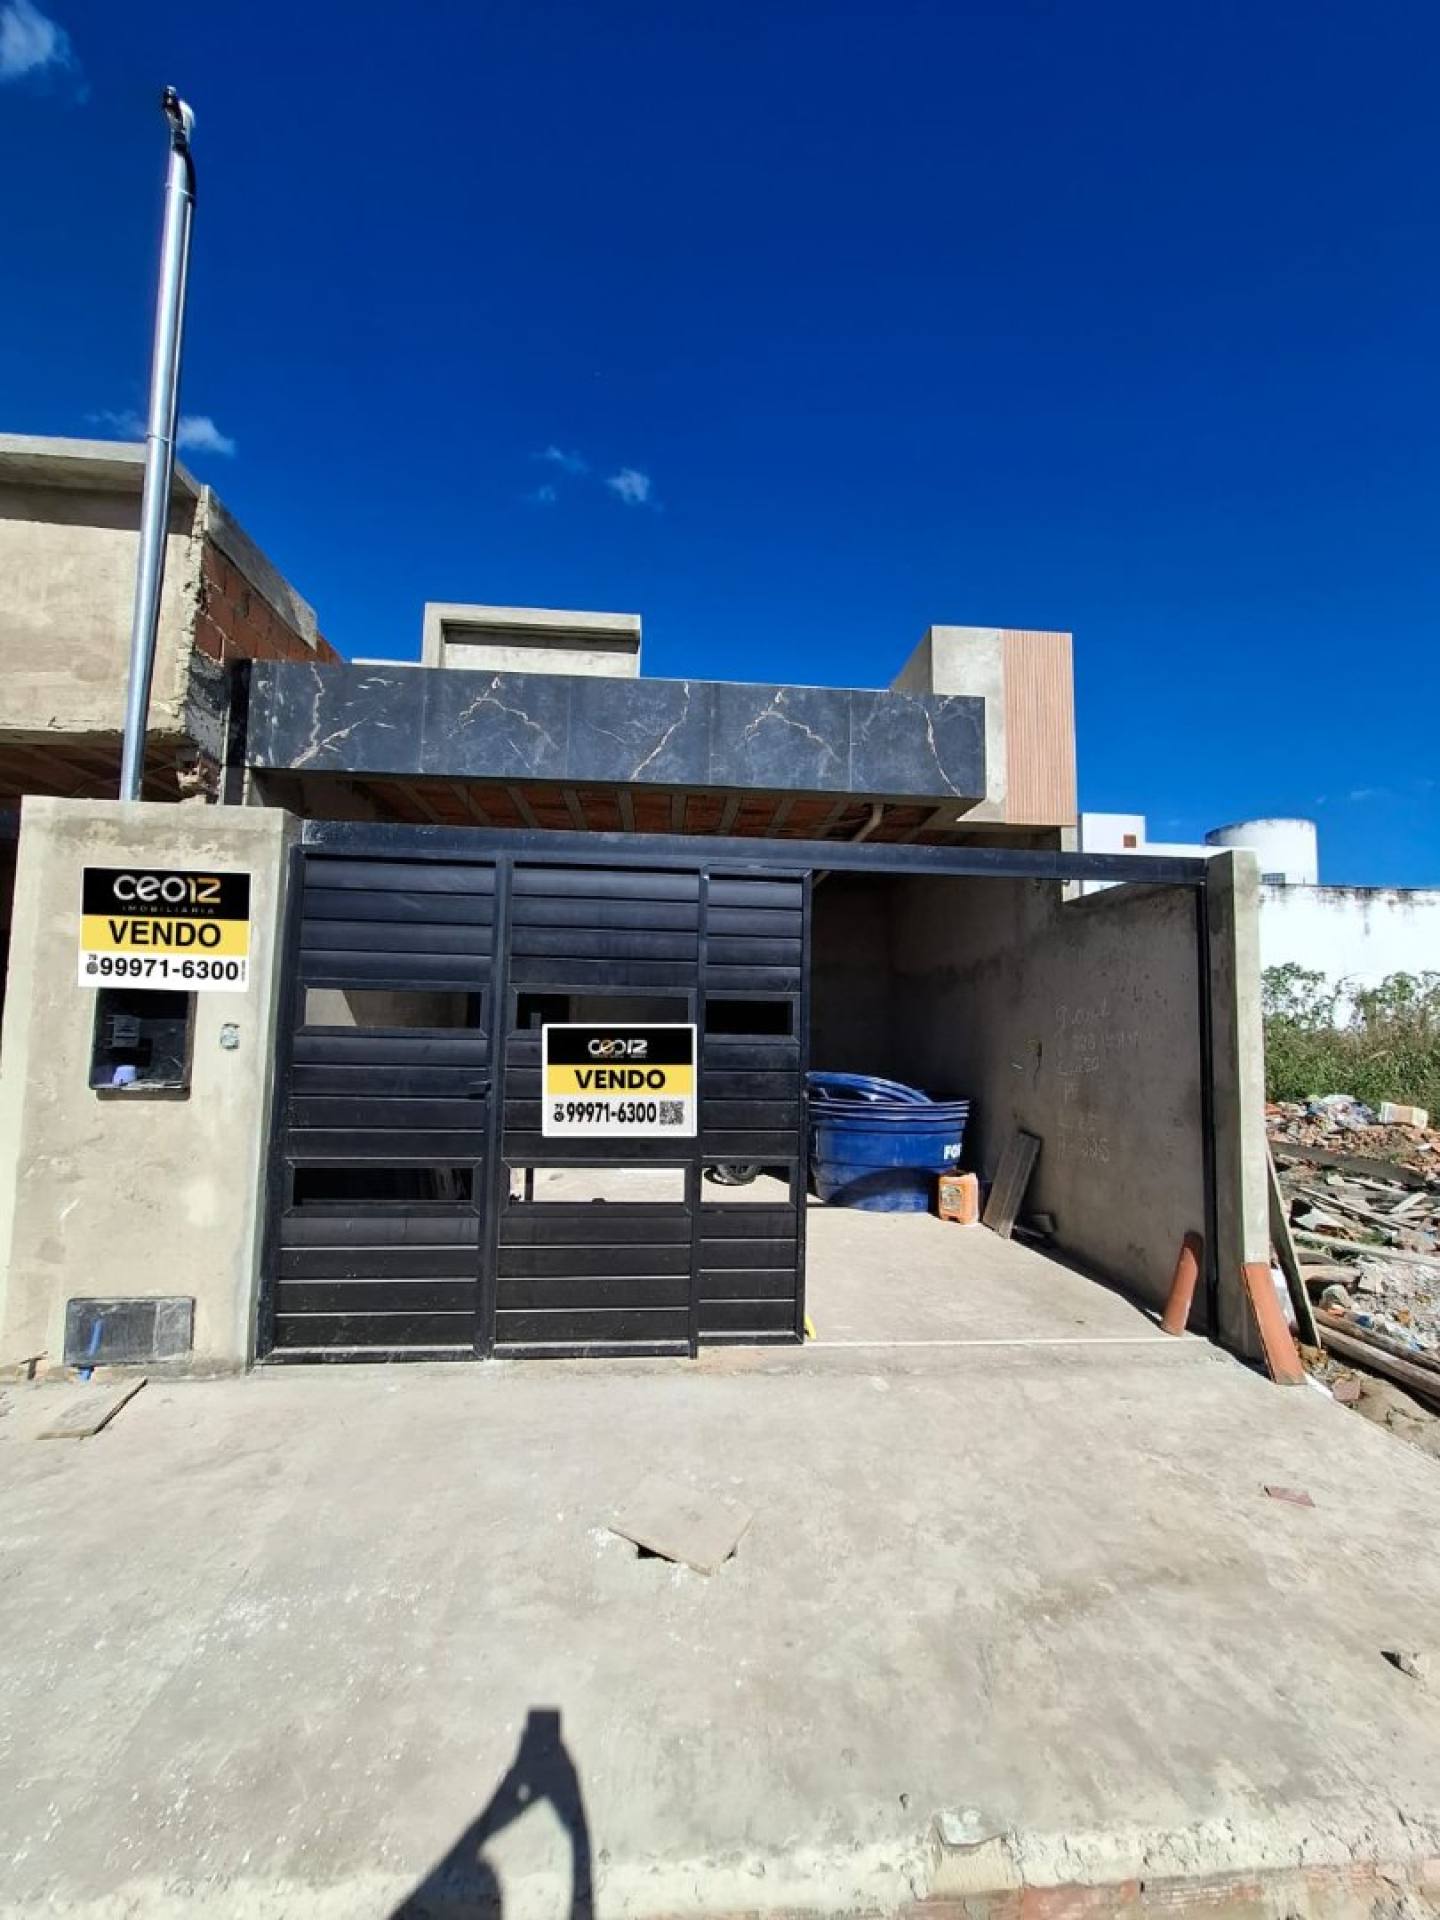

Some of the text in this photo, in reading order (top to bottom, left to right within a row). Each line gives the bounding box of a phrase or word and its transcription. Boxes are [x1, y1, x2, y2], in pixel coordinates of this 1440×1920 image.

[109, 919, 222, 948] VENDO
[100, 957, 239, 980] 99971-6300
[574, 1069, 667, 1090] VENDO
[566, 1101, 657, 1123] 99971-6300
